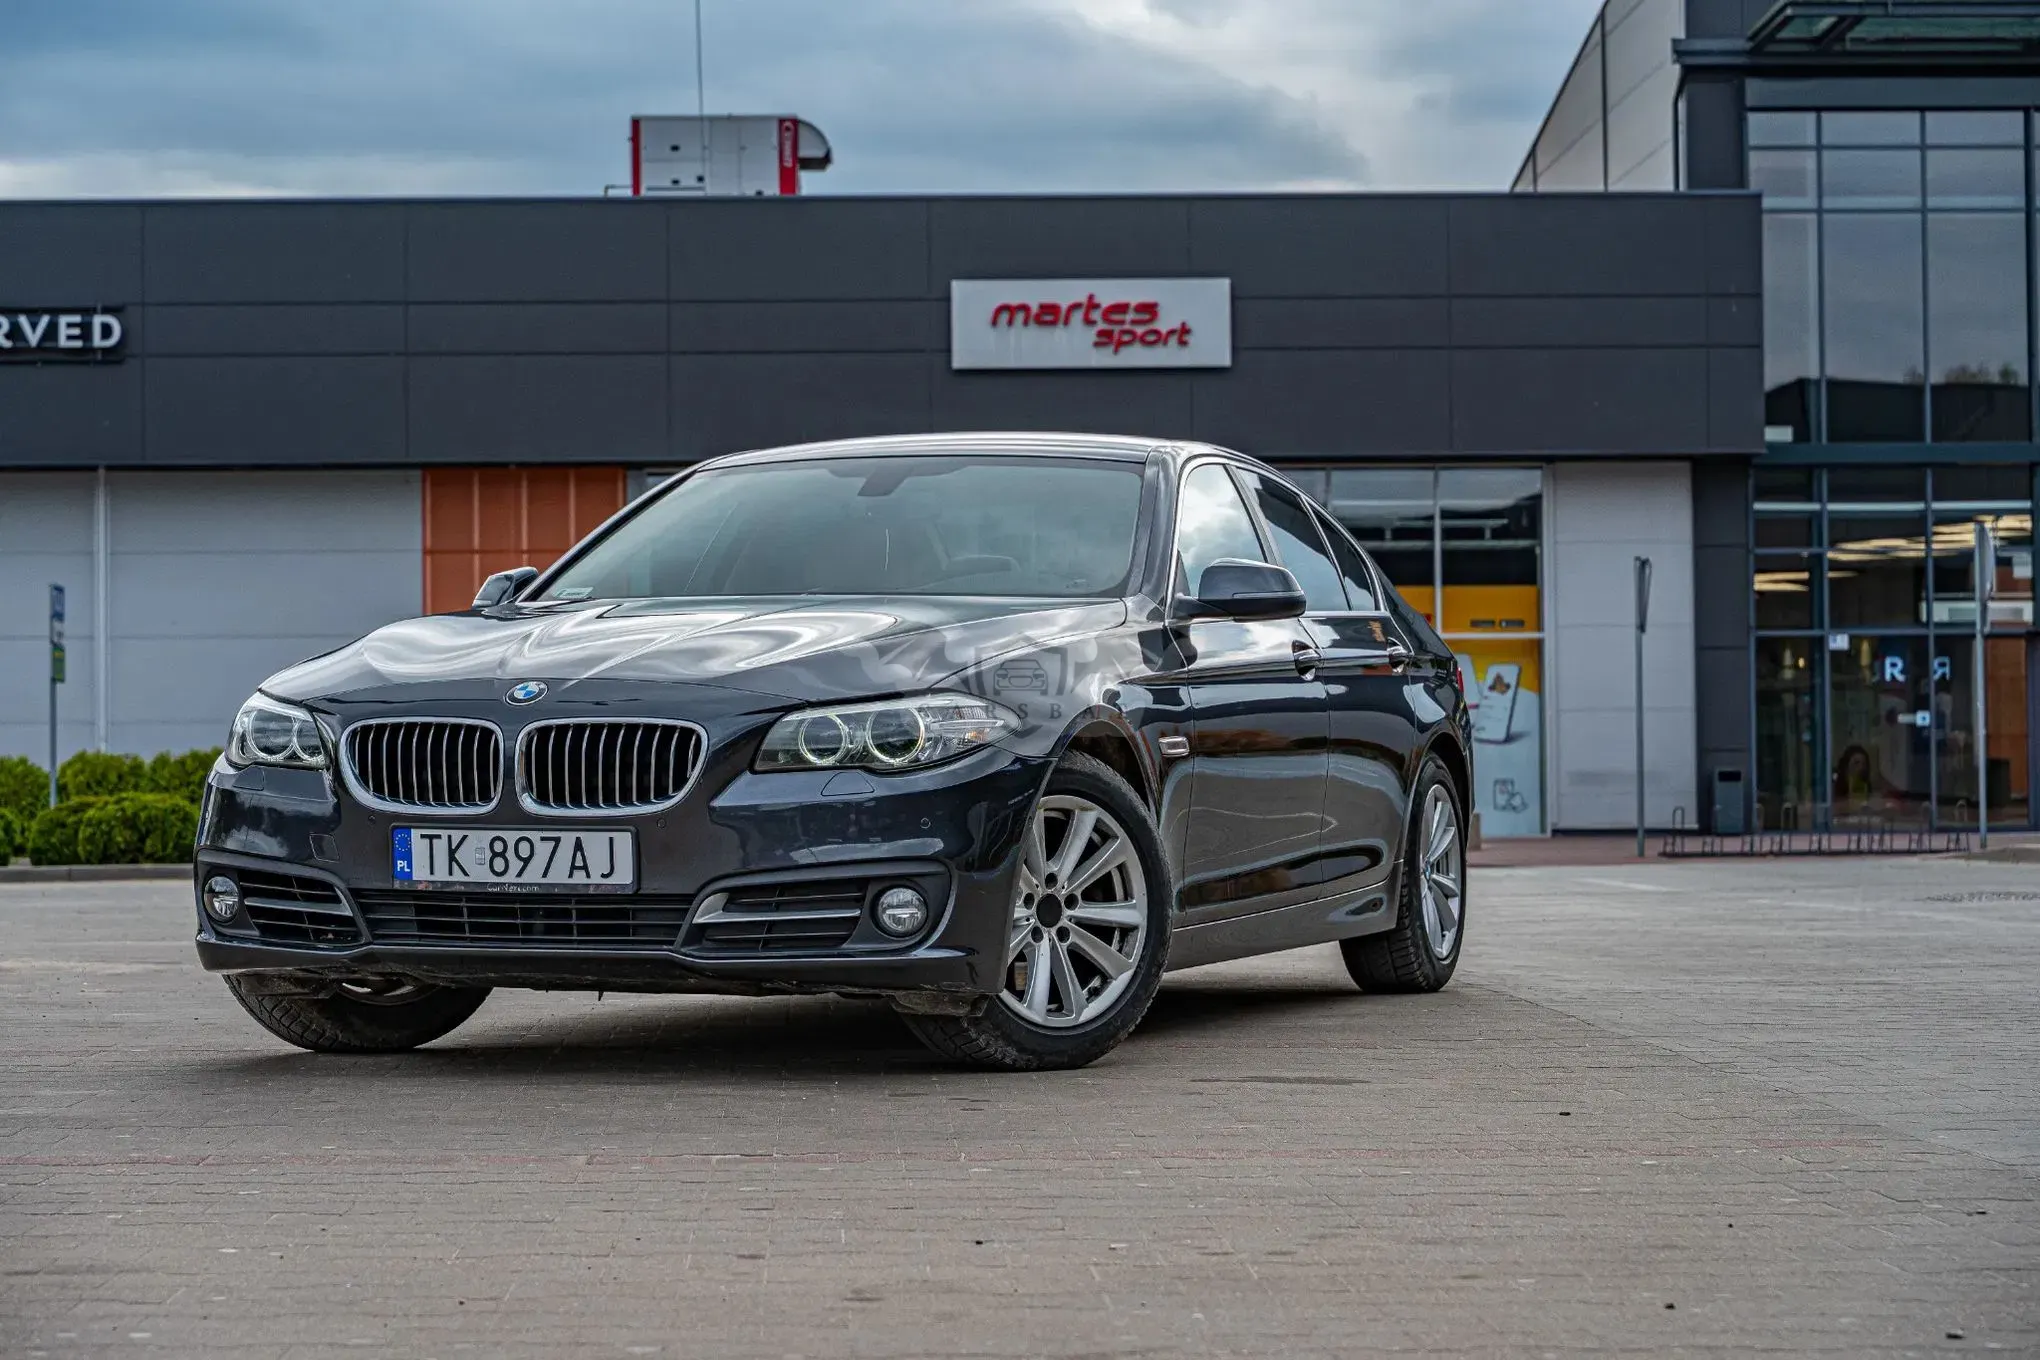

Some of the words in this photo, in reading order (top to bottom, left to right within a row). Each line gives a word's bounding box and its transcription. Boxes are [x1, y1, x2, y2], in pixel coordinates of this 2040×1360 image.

[991, 293, 1160, 328] martes
[1093, 321, 1192, 355] sport
[1885, 656, 1905, 682] R
[397, 860, 411, 872] PL
[420, 833, 470, 877] TK
[488, 835, 615, 880] 897AJ
